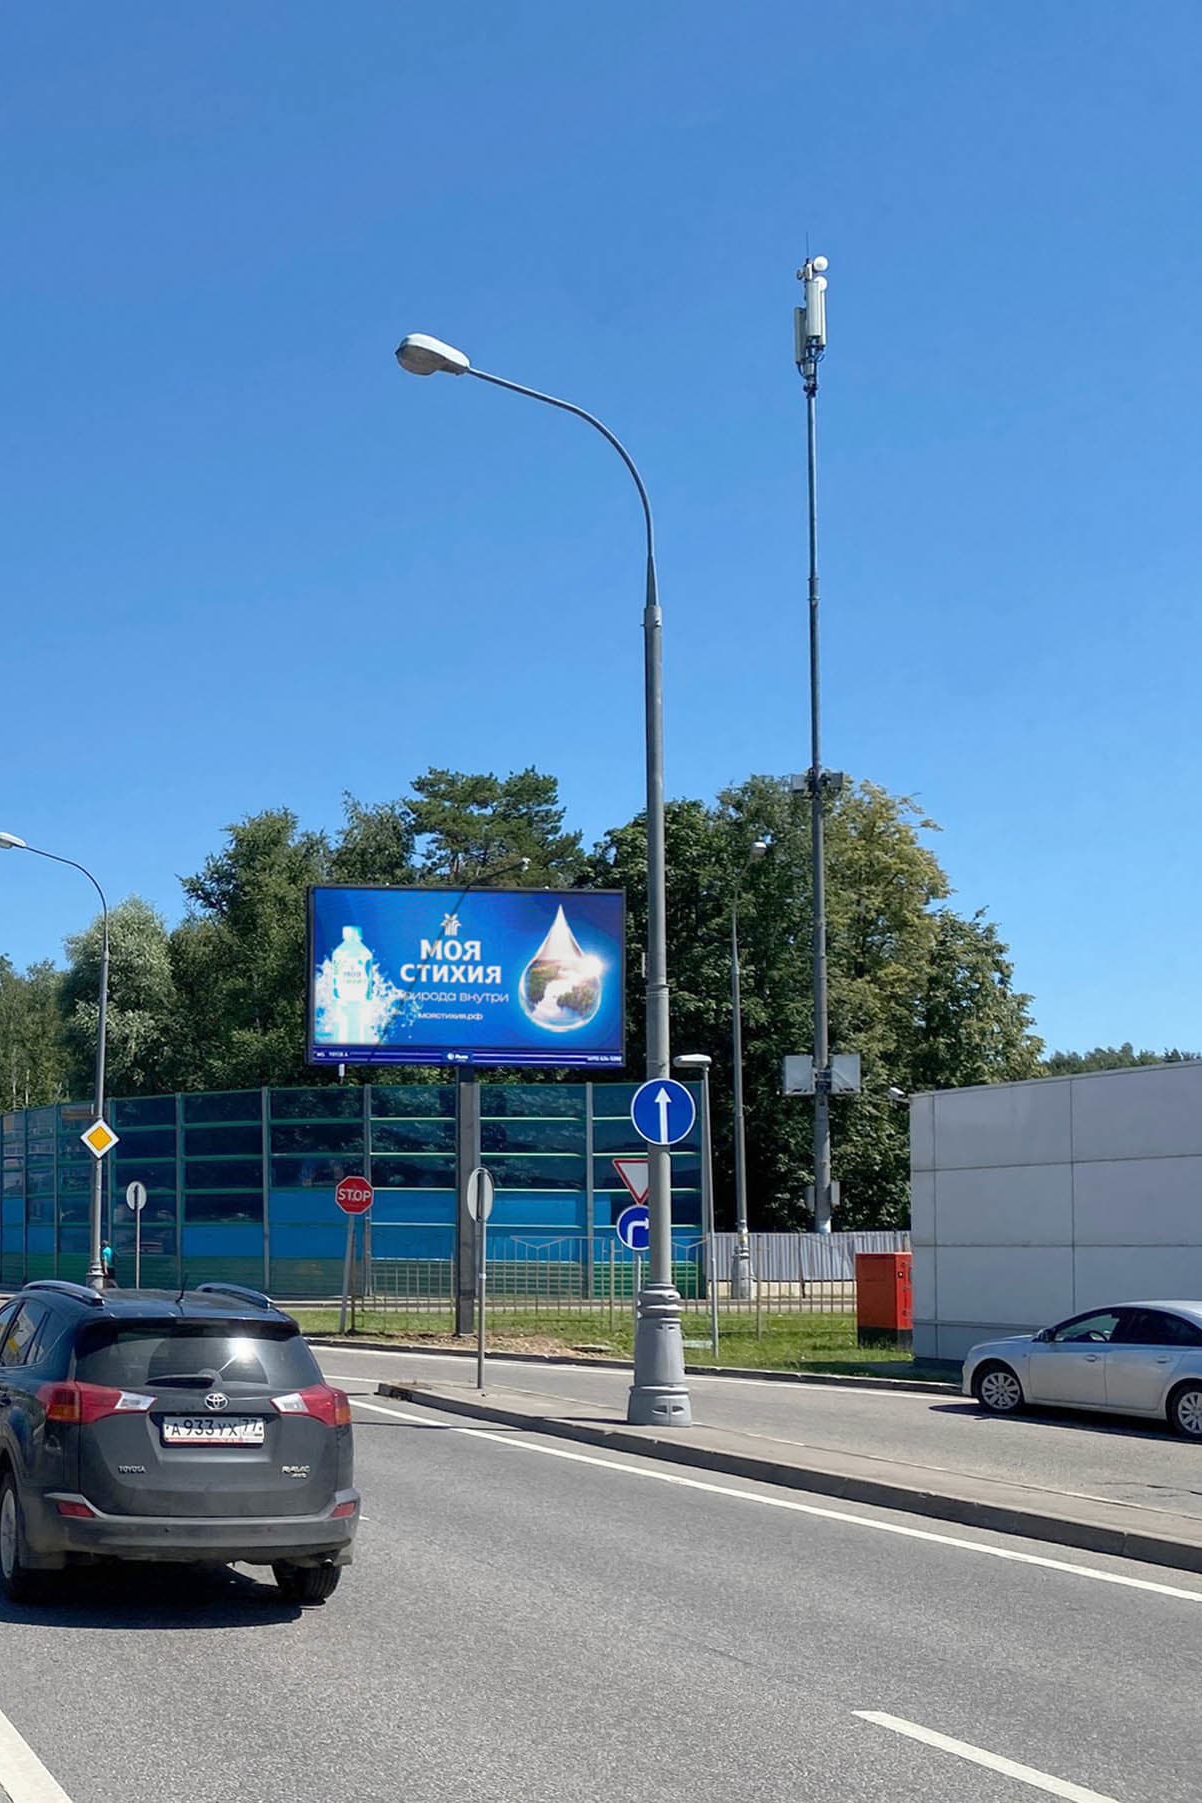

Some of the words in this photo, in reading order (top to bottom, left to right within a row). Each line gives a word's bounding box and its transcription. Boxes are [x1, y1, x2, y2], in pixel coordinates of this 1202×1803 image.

[420, 939, 481, 961] МОЯ
[400, 963, 502, 985] СТИХИЯ
[396, 991, 456, 1003] рирода
[459, 991, 509, 1004] внутри
[338, 1188, 372, 1202] STOP
